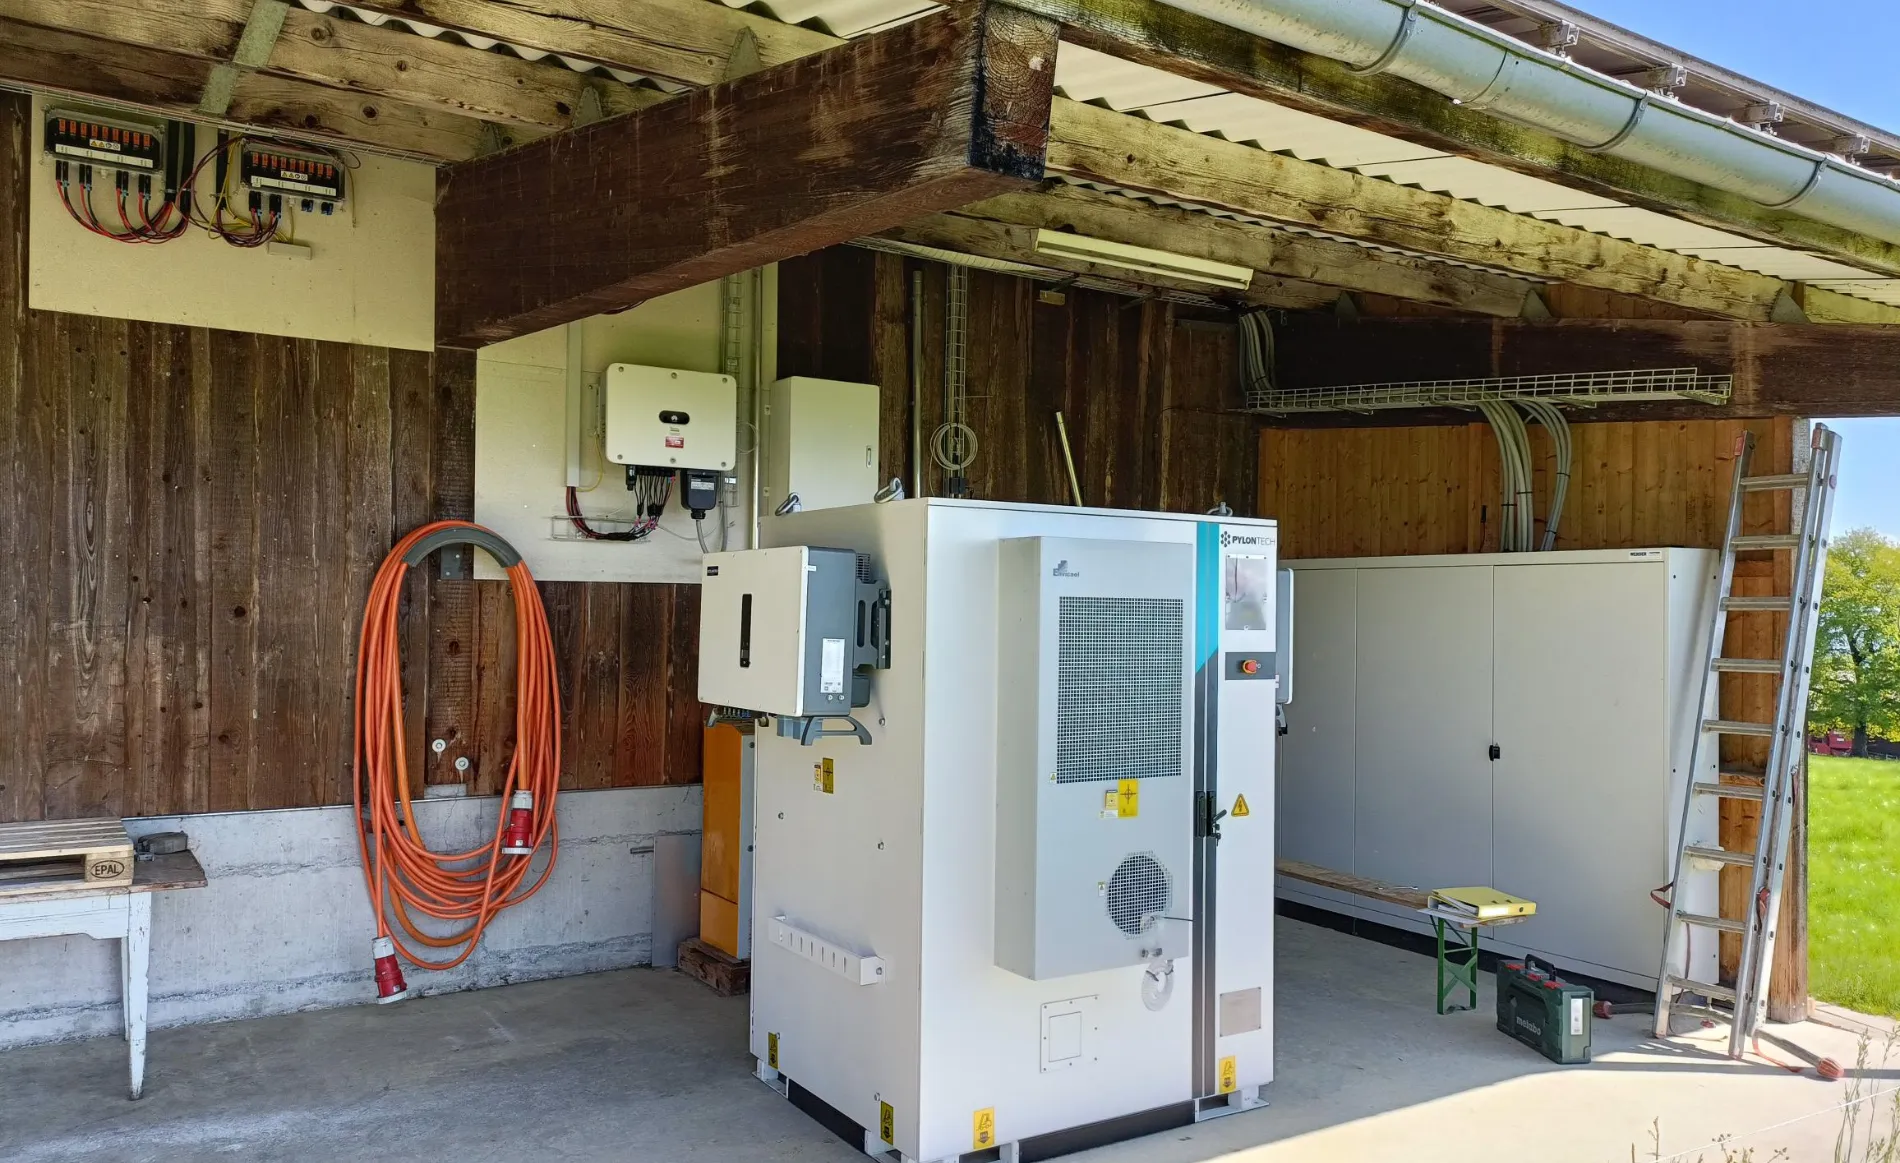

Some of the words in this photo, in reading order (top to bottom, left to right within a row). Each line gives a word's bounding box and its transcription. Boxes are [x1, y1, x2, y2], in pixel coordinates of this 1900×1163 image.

[1232, 535, 1275, 546] PYLONTECH
[94, 864, 119, 876] EPAL
[1516, 1016, 1542, 1036] metabo
